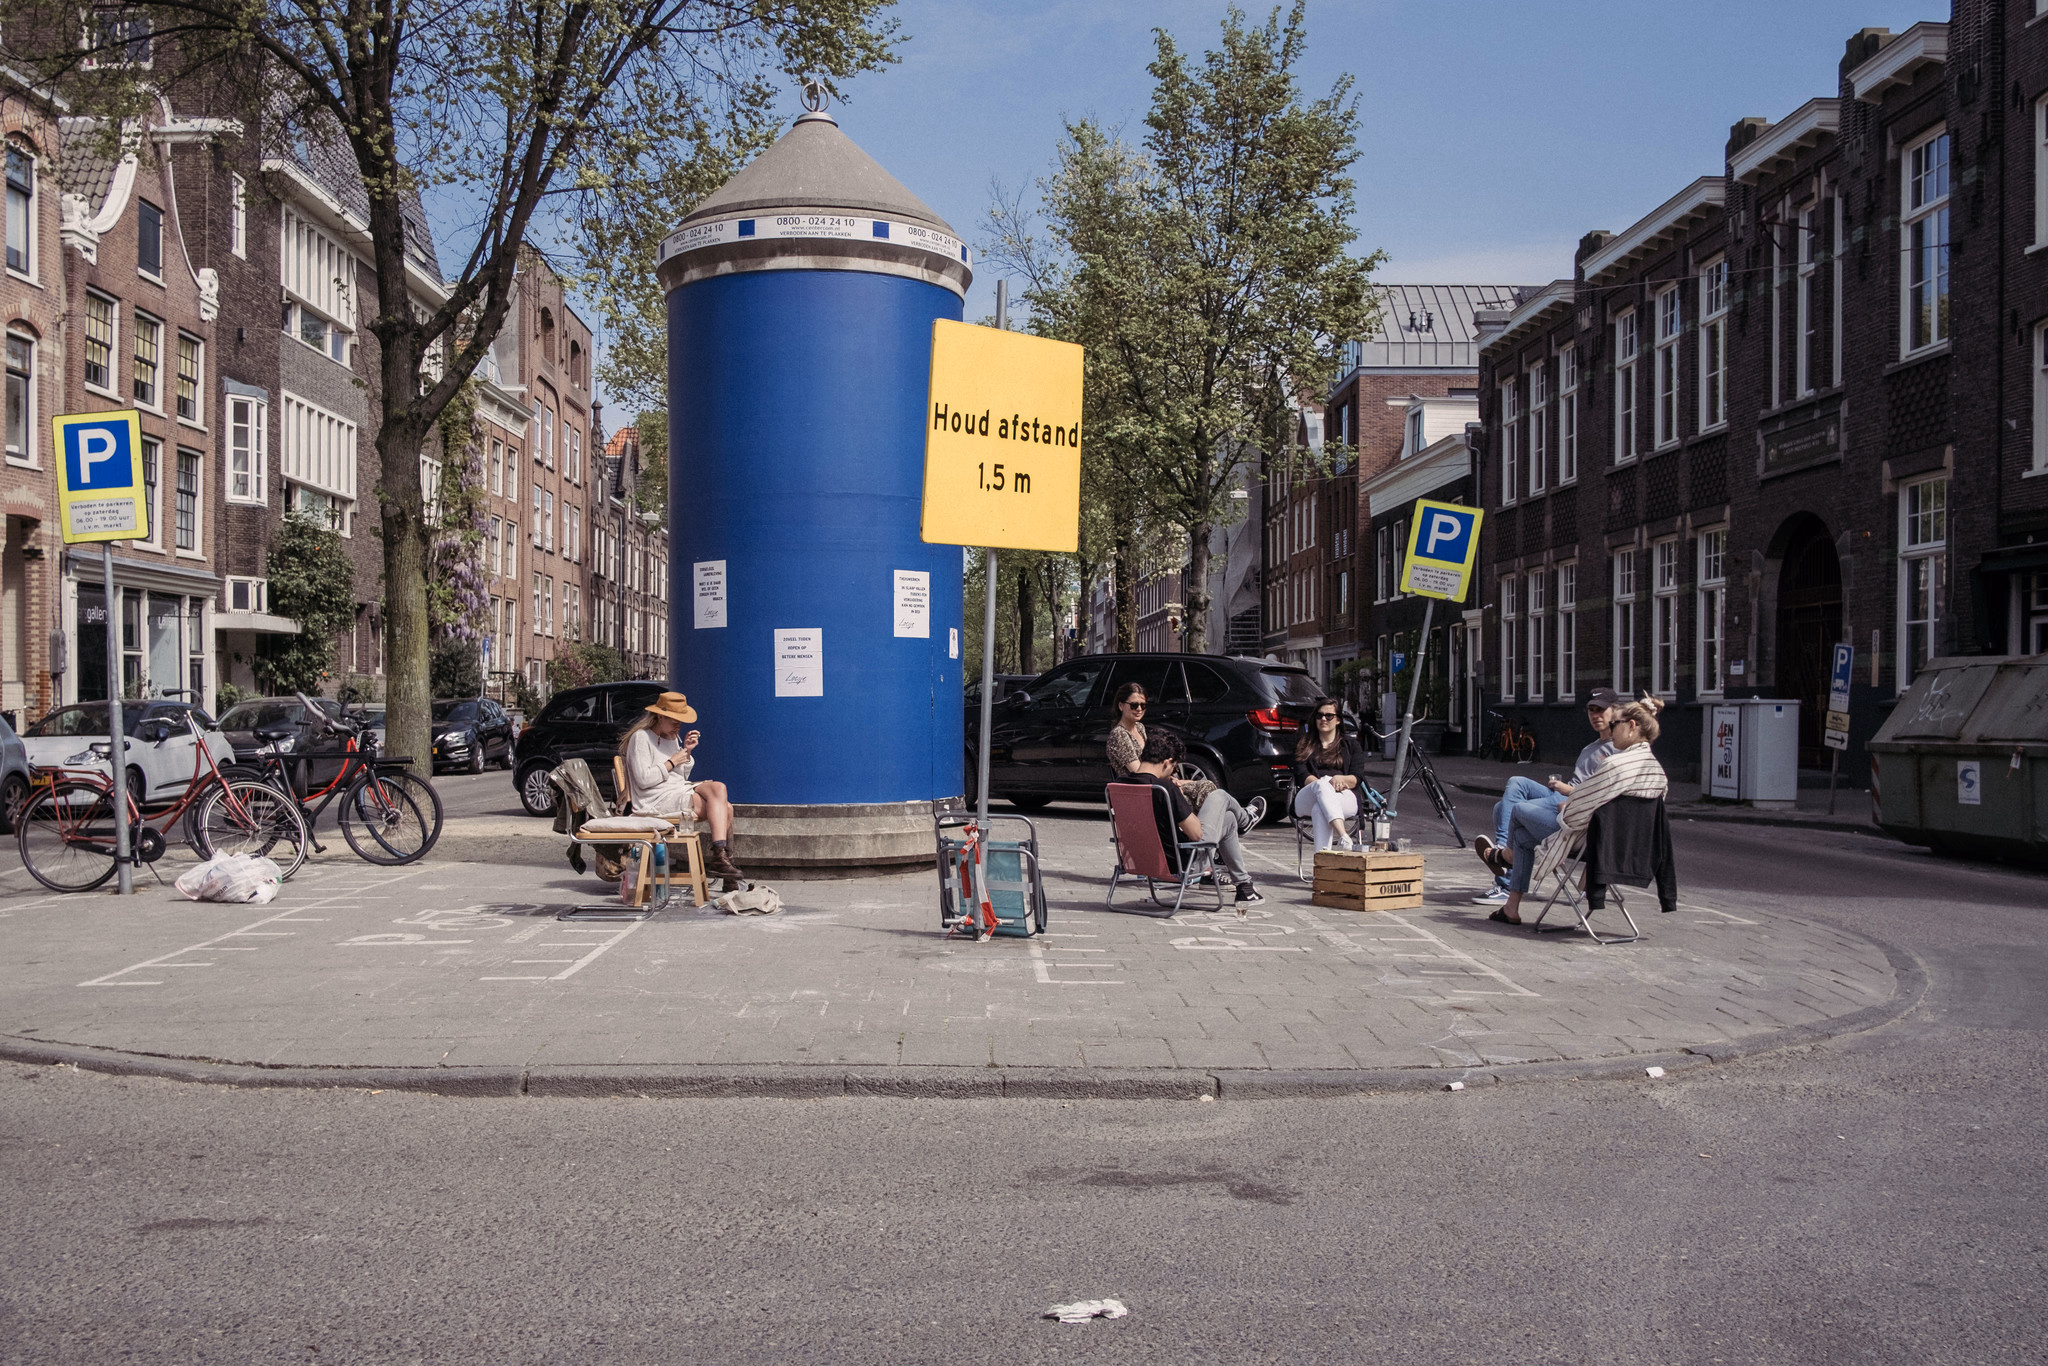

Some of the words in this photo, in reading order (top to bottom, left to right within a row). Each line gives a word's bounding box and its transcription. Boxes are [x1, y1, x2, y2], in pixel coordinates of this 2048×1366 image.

[776, 217, 800, 226] 0800
[808, 217, 826, 225] 024
[830, 218, 840, 226] 24
[672, 232, 685, 244] 0800
[690, 229, 701, 238] 024
[704, 226, 712, 234] 24
[714, 224, 724, 232] 10
[908, 227, 926, 237] 0800
[932, 232, 942, 242] 024
[944, 236, 951, 245] 24
[934, 402, 990, 437] Houd
[998, 414, 1078, 448] afstand
[78, 428, 117, 484] P
[978, 462, 1005, 492] 1,5
[1014, 472, 1031, 494] m
[1426, 513, 1461, 554] P
[1396, 658, 1401, 667] P
[1837, 648, 1848, 673] P
[1717, 720, 1725, 747] 4
[1724, 723, 1734, 737] EN
[1718, 764, 1731, 779] MEI
[1380, 883, 1411, 895] JUMBO
